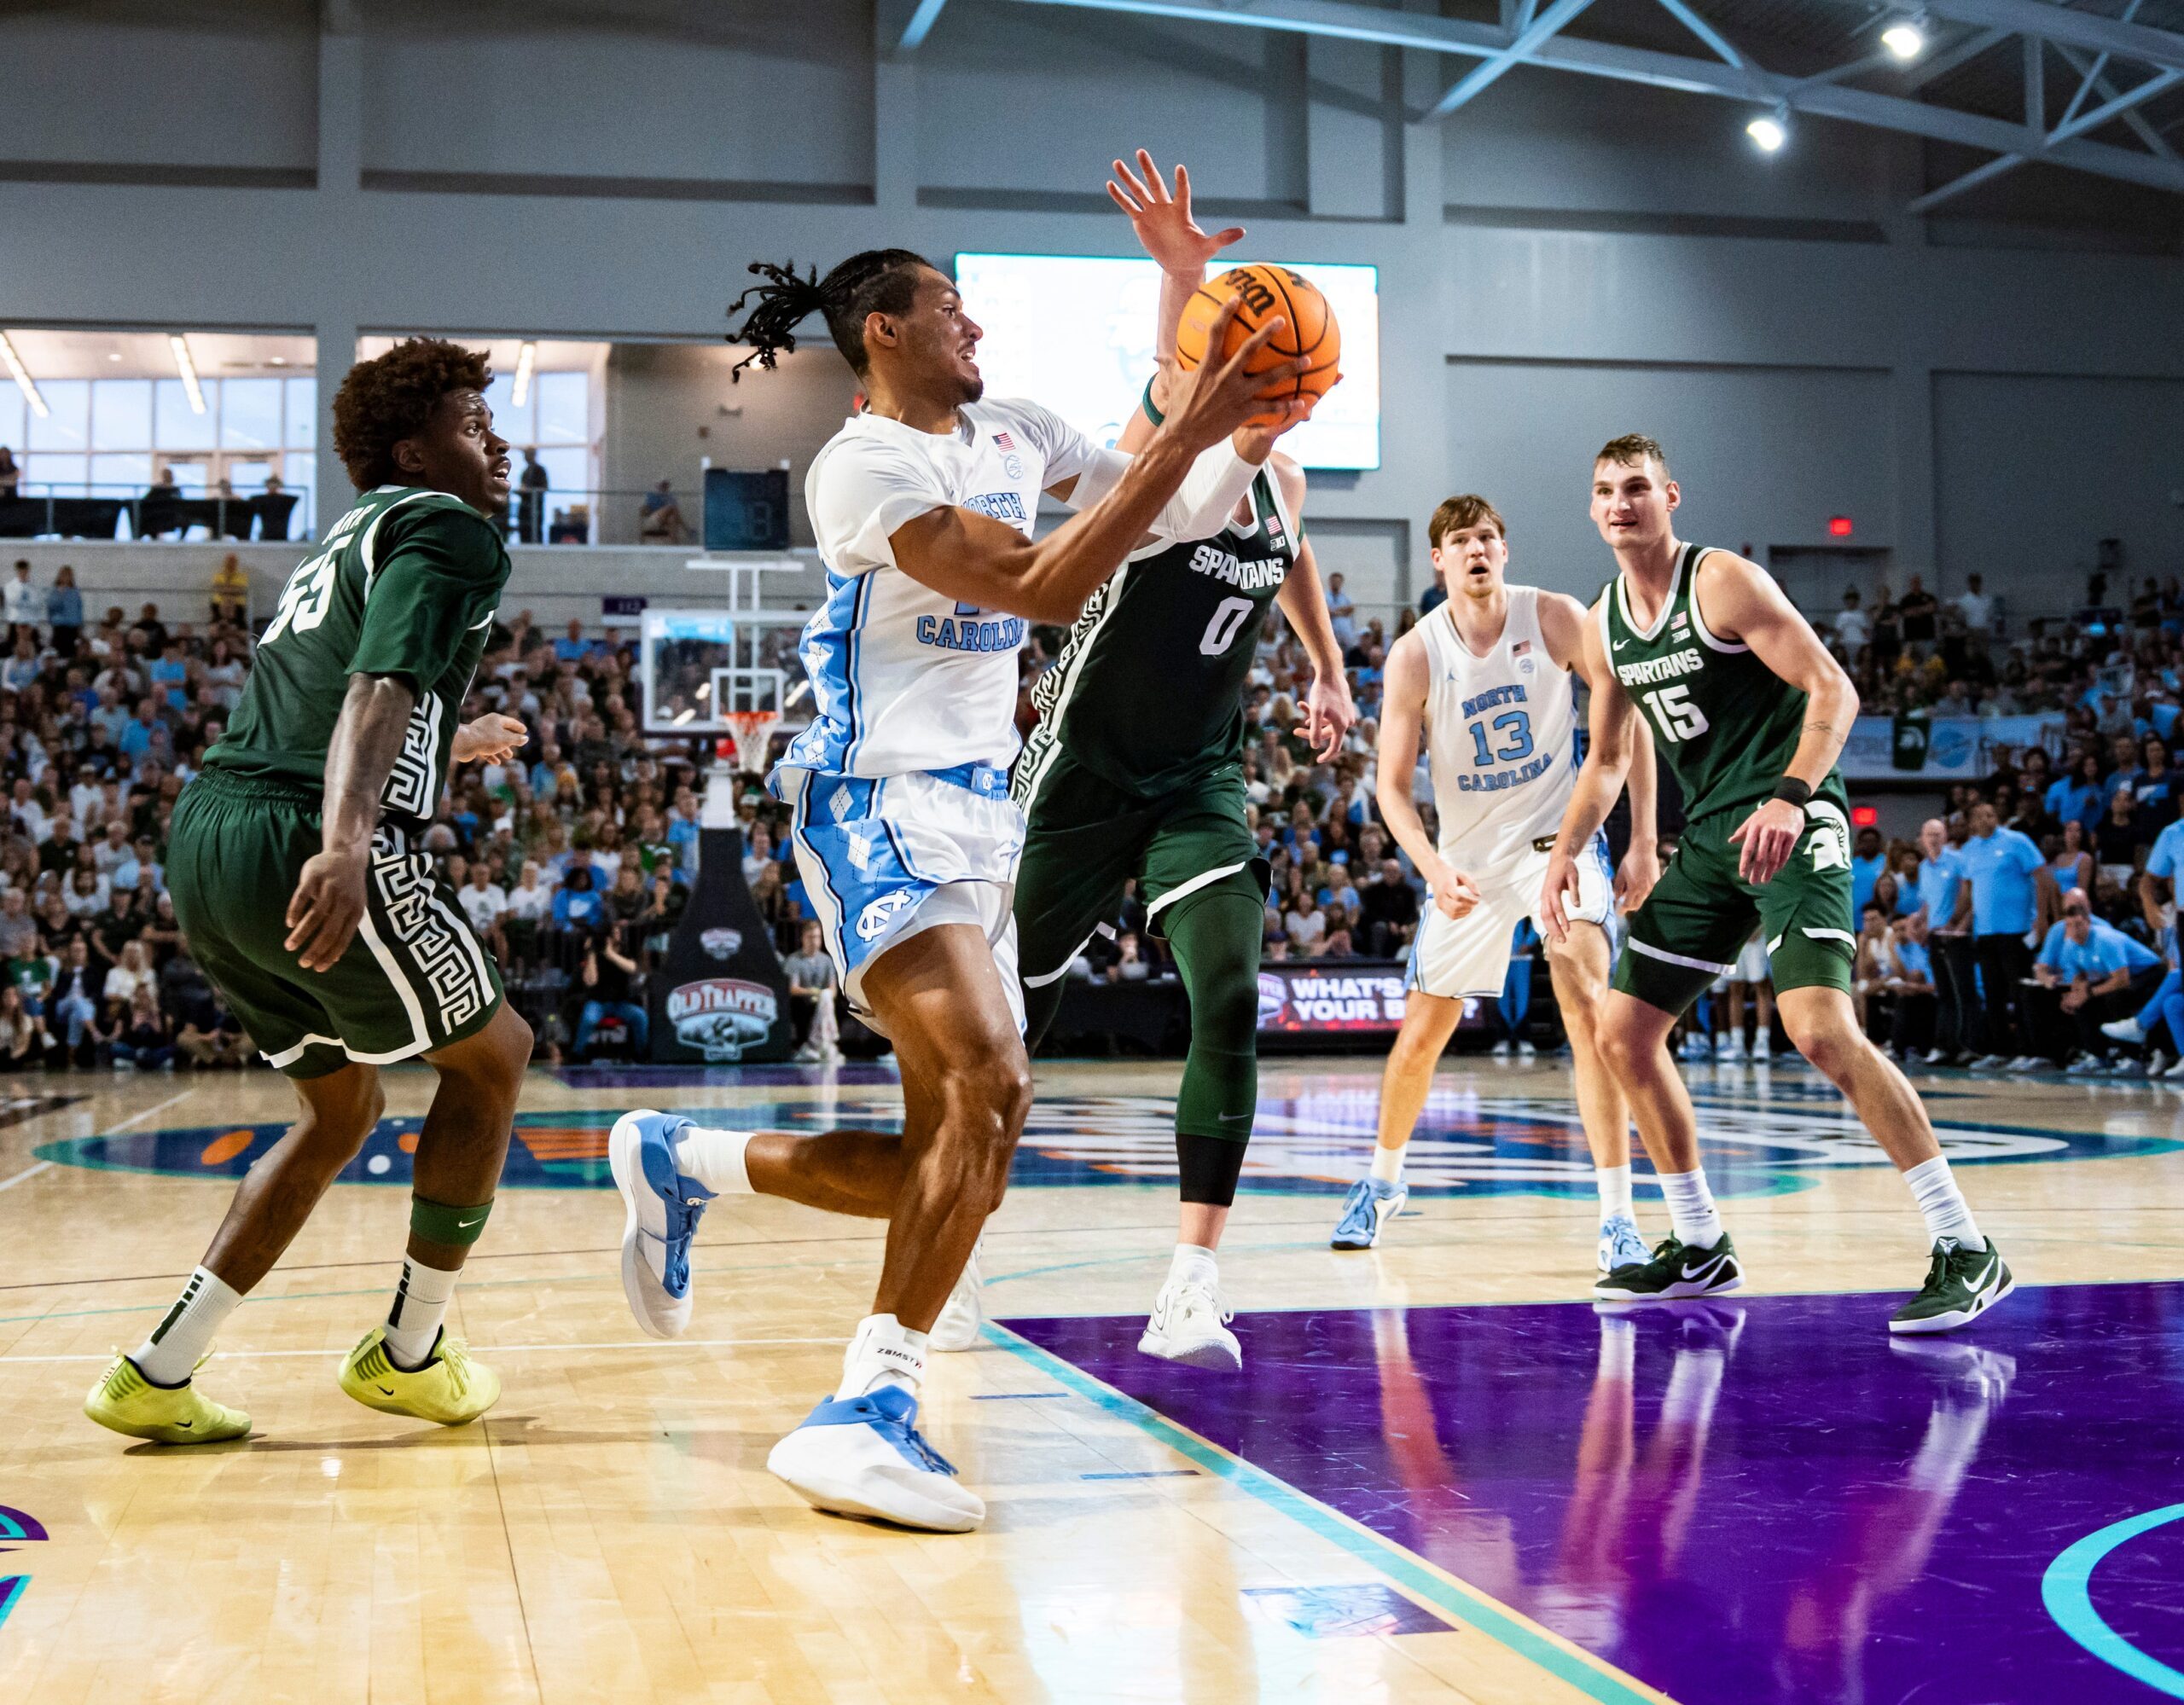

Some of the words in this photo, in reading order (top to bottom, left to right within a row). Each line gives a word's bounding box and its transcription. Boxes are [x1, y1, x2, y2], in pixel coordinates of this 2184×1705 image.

[961, 492, 1026, 519] ORTH
[1188, 544, 1285, 590] SPARTANS
[257, 532, 355, 649] 55
[916, 616, 1024, 652] CAROLIN
[1199, 595, 1254, 656] 0
[1617, 647, 1705, 687] SPARTANS
[1461, 684, 1528, 720] NORTH
[1642, 684, 1710, 743] 15
[1469, 710, 1534, 767] 13
[1457, 752, 1553, 792] CAROLINA
[1291, 977, 1405, 999] WHAT'S
[1292, 999, 1379, 1021] YOUR
